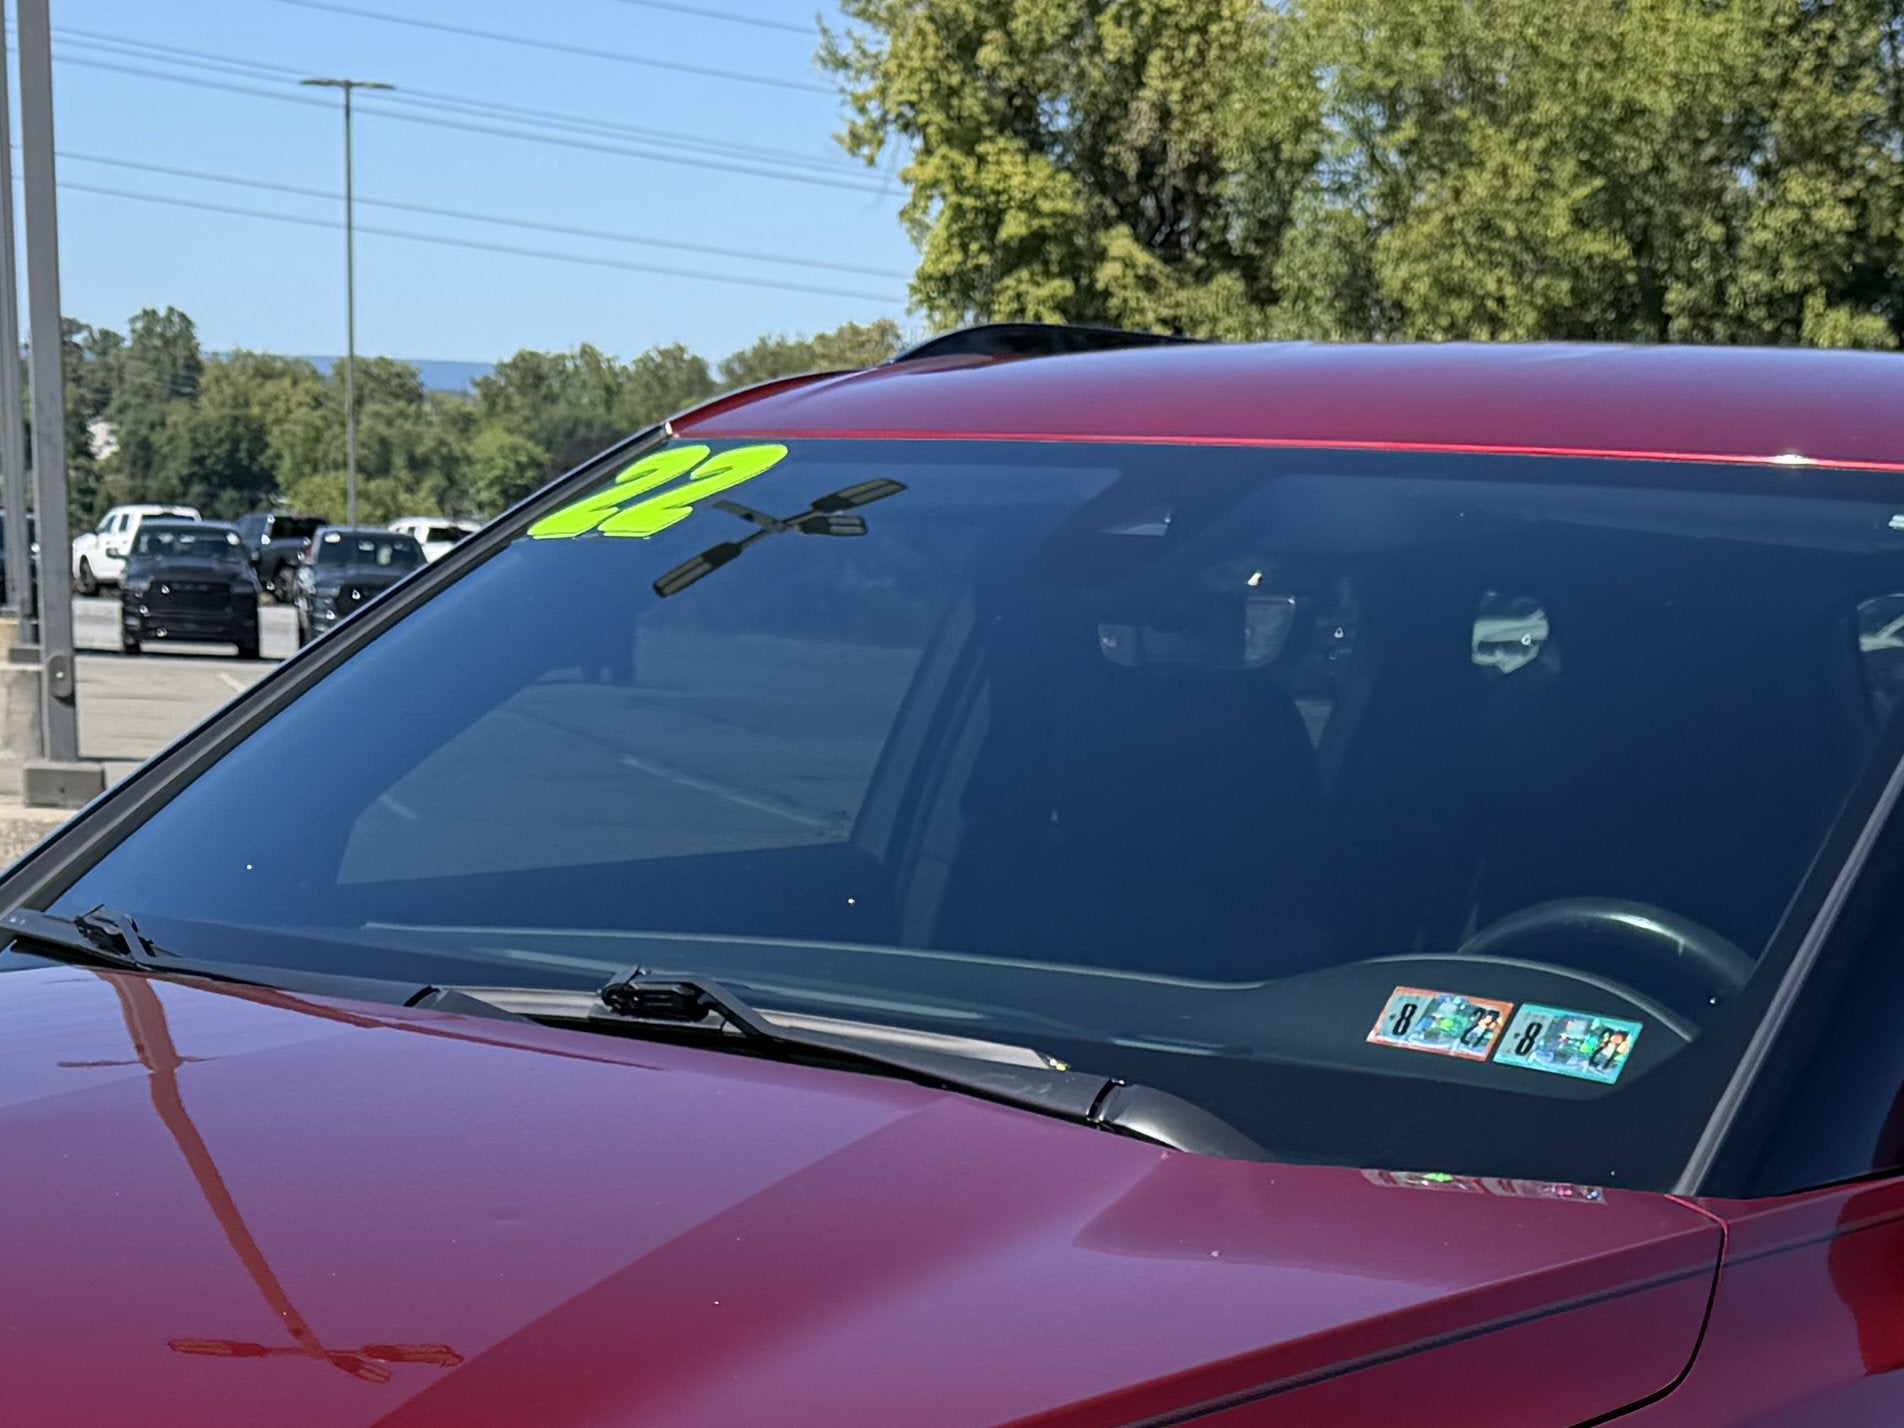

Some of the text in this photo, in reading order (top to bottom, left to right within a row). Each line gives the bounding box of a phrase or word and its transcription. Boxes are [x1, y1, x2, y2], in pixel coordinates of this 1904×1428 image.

[527, 444, 788, 540] 22
[1392, 1003, 1418, 1036] 8
[1516, 1022, 1543, 1056] 8
